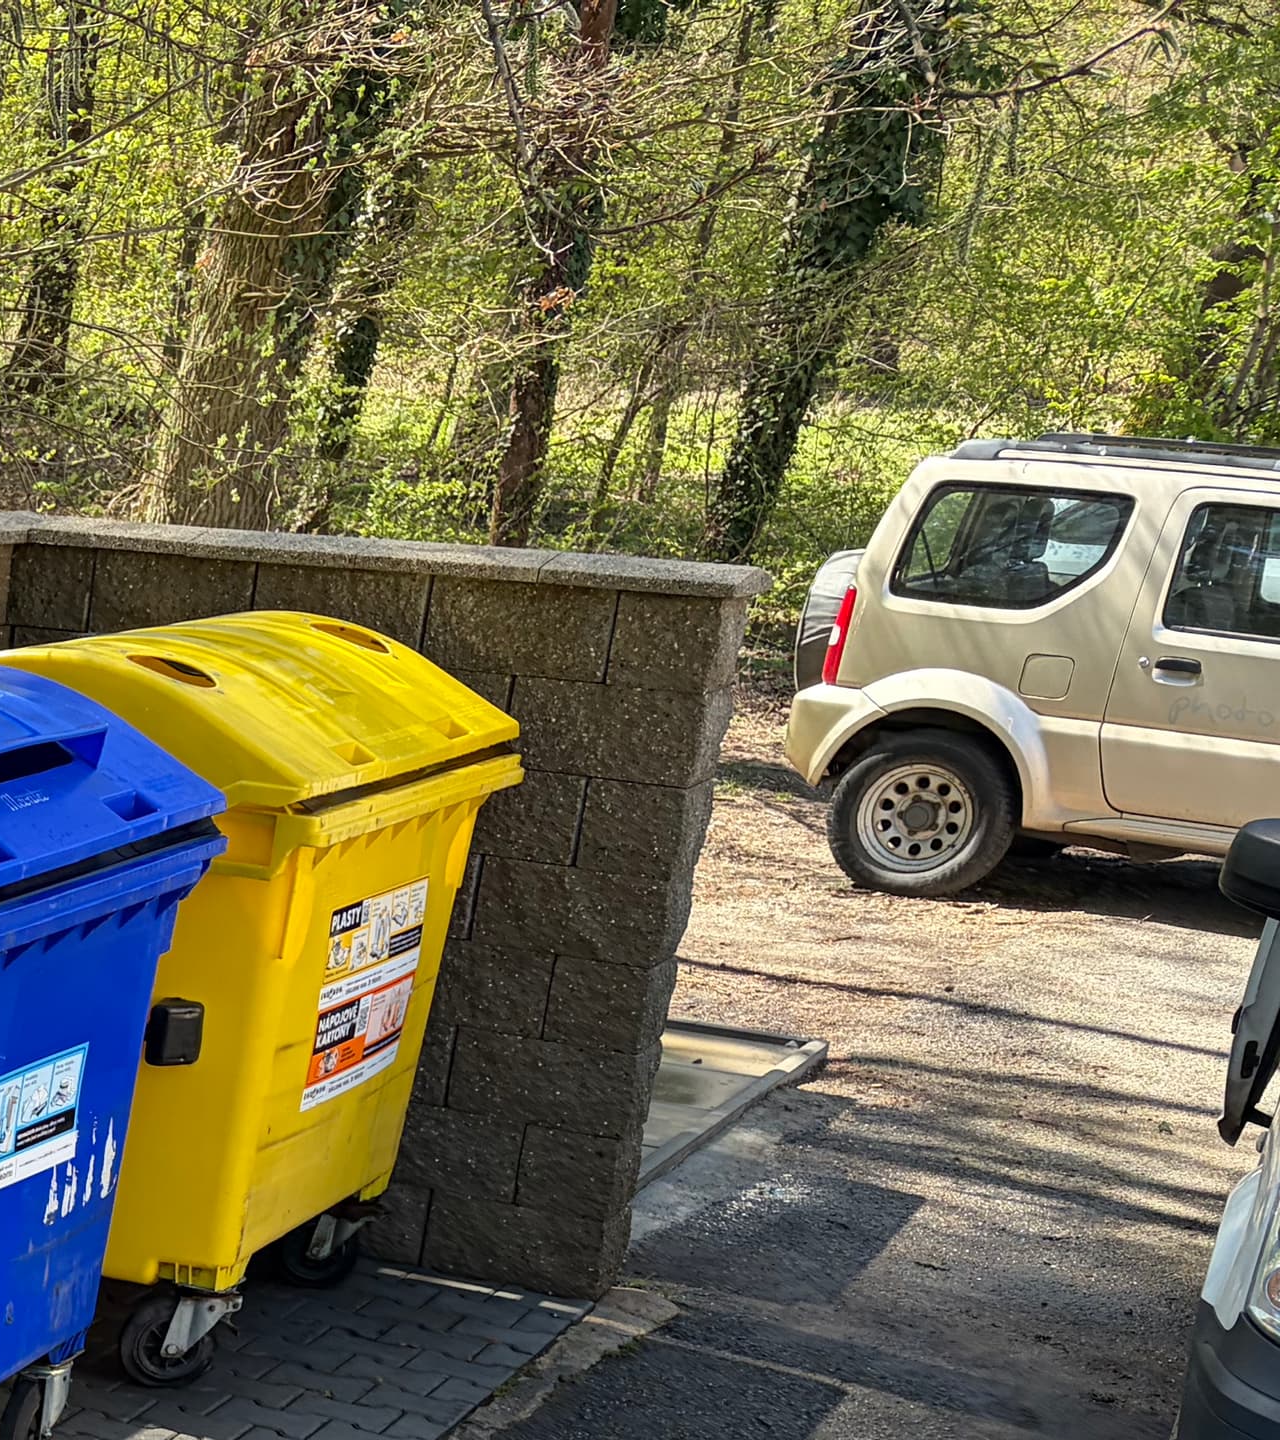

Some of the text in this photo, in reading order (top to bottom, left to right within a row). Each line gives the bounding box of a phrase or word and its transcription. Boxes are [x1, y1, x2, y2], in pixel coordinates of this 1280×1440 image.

[331, 903, 360, 932] PLASTY
[318, 1001, 358, 1033] NÁPOJOVÉ
[316, 1023, 351, 1048] KARTONY
